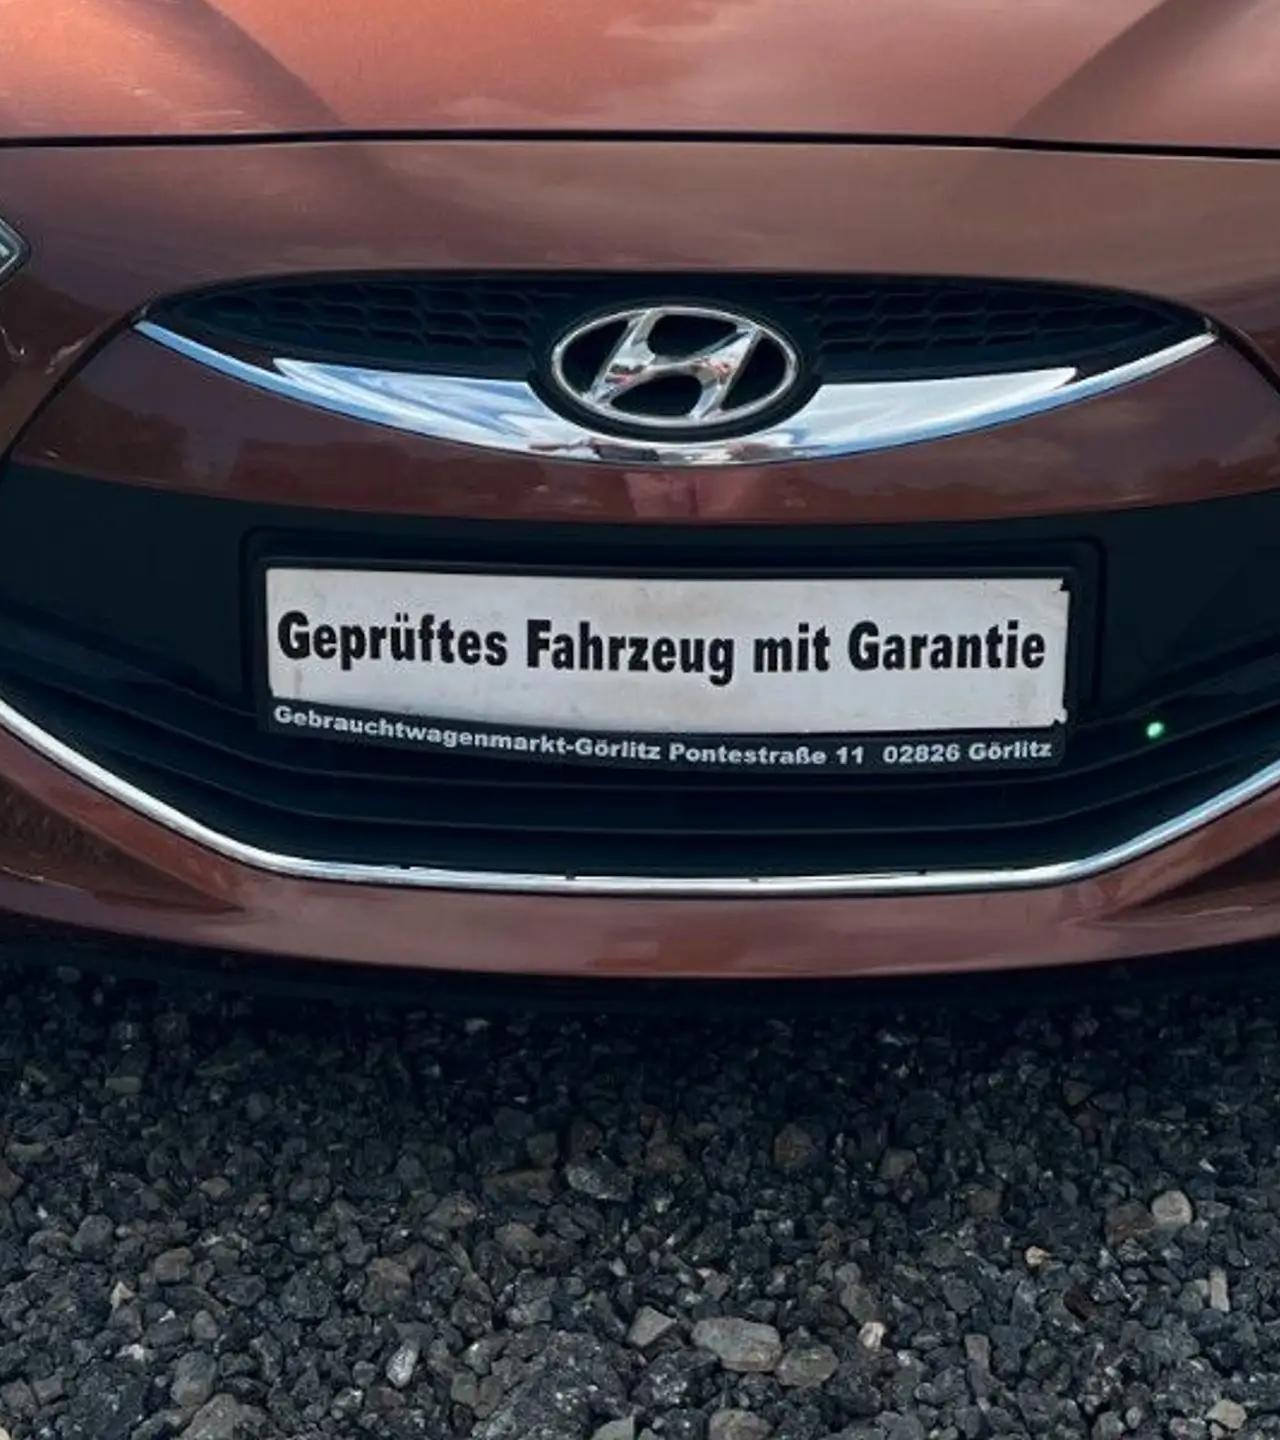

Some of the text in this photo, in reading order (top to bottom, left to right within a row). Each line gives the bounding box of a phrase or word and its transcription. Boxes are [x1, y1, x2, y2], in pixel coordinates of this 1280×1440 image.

[277, 610, 1047, 686] Geprüftes Fahrzeug mit Garantie
[273, 704, 1053, 766] Gebrauchtwagenmarkt-Görlitz Pontestraße 11 02826 Görlitz
